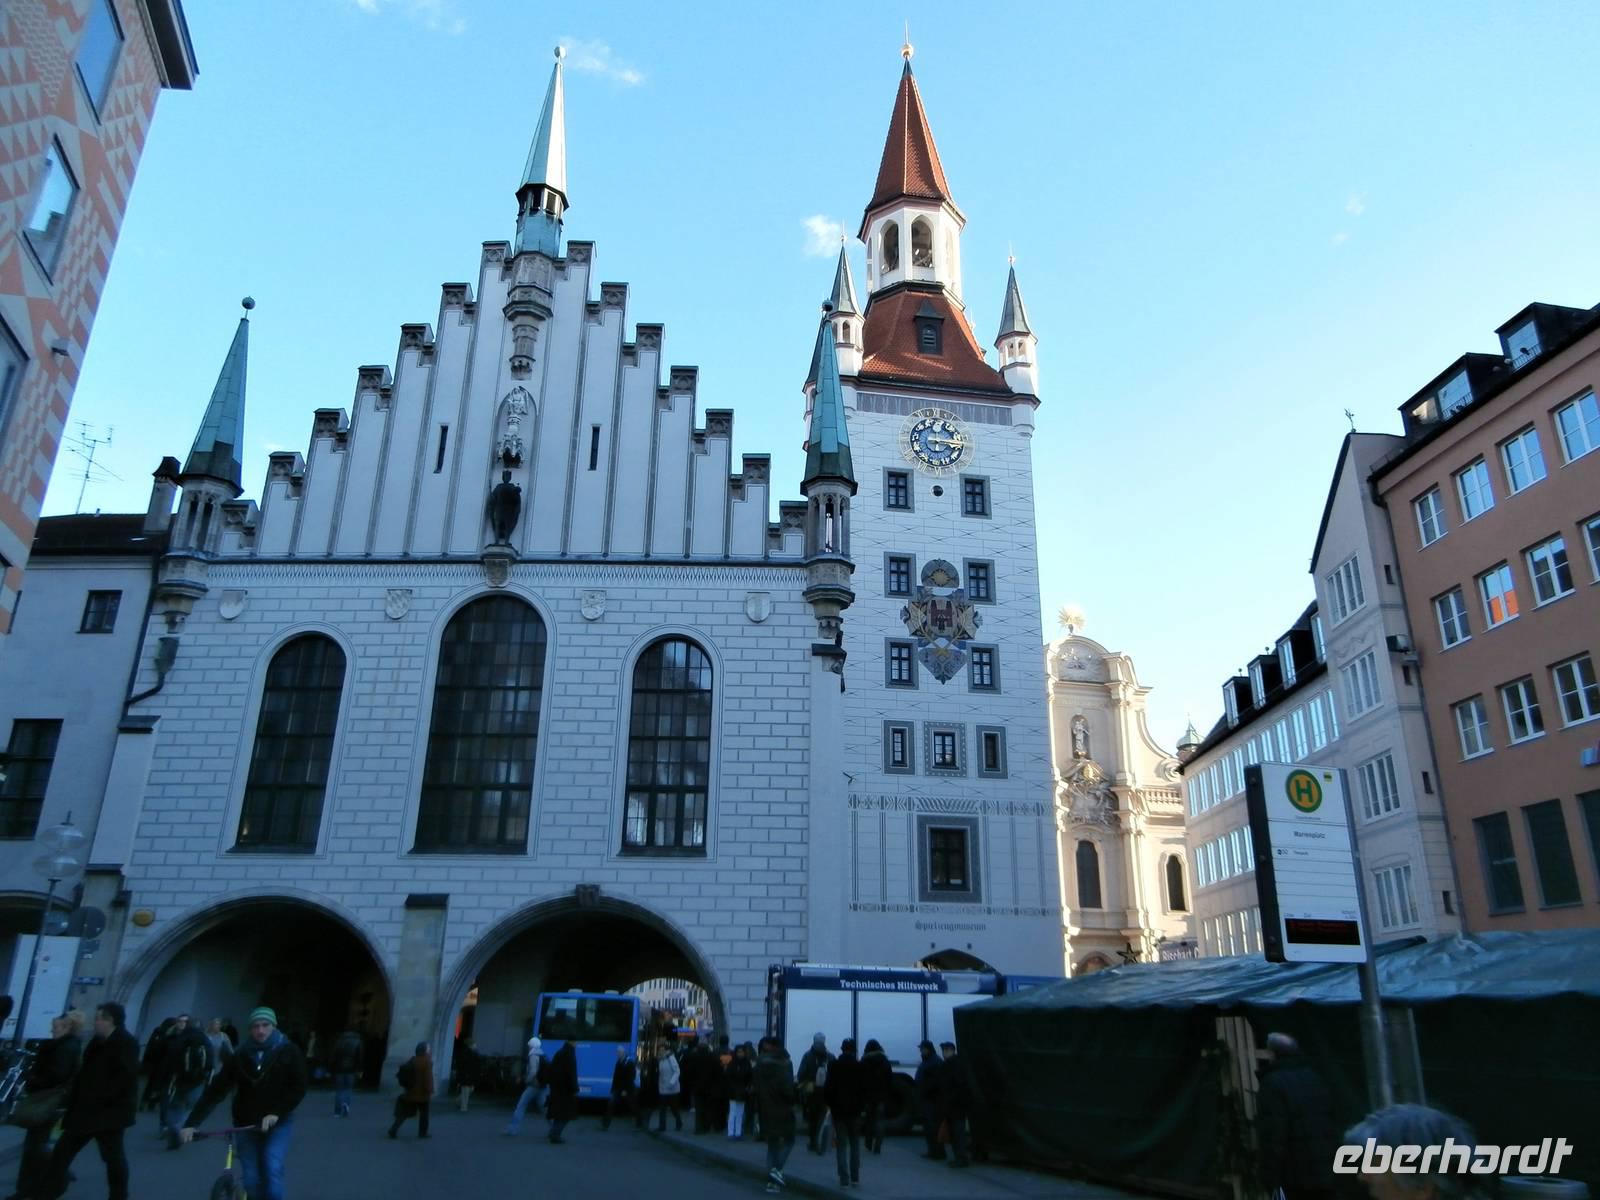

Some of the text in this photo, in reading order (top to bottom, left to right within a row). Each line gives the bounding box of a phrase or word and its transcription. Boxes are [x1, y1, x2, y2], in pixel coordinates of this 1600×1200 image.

[1294, 779, 1313, 803] H
[840, 979, 939, 991] Technisches Hilfswerk
